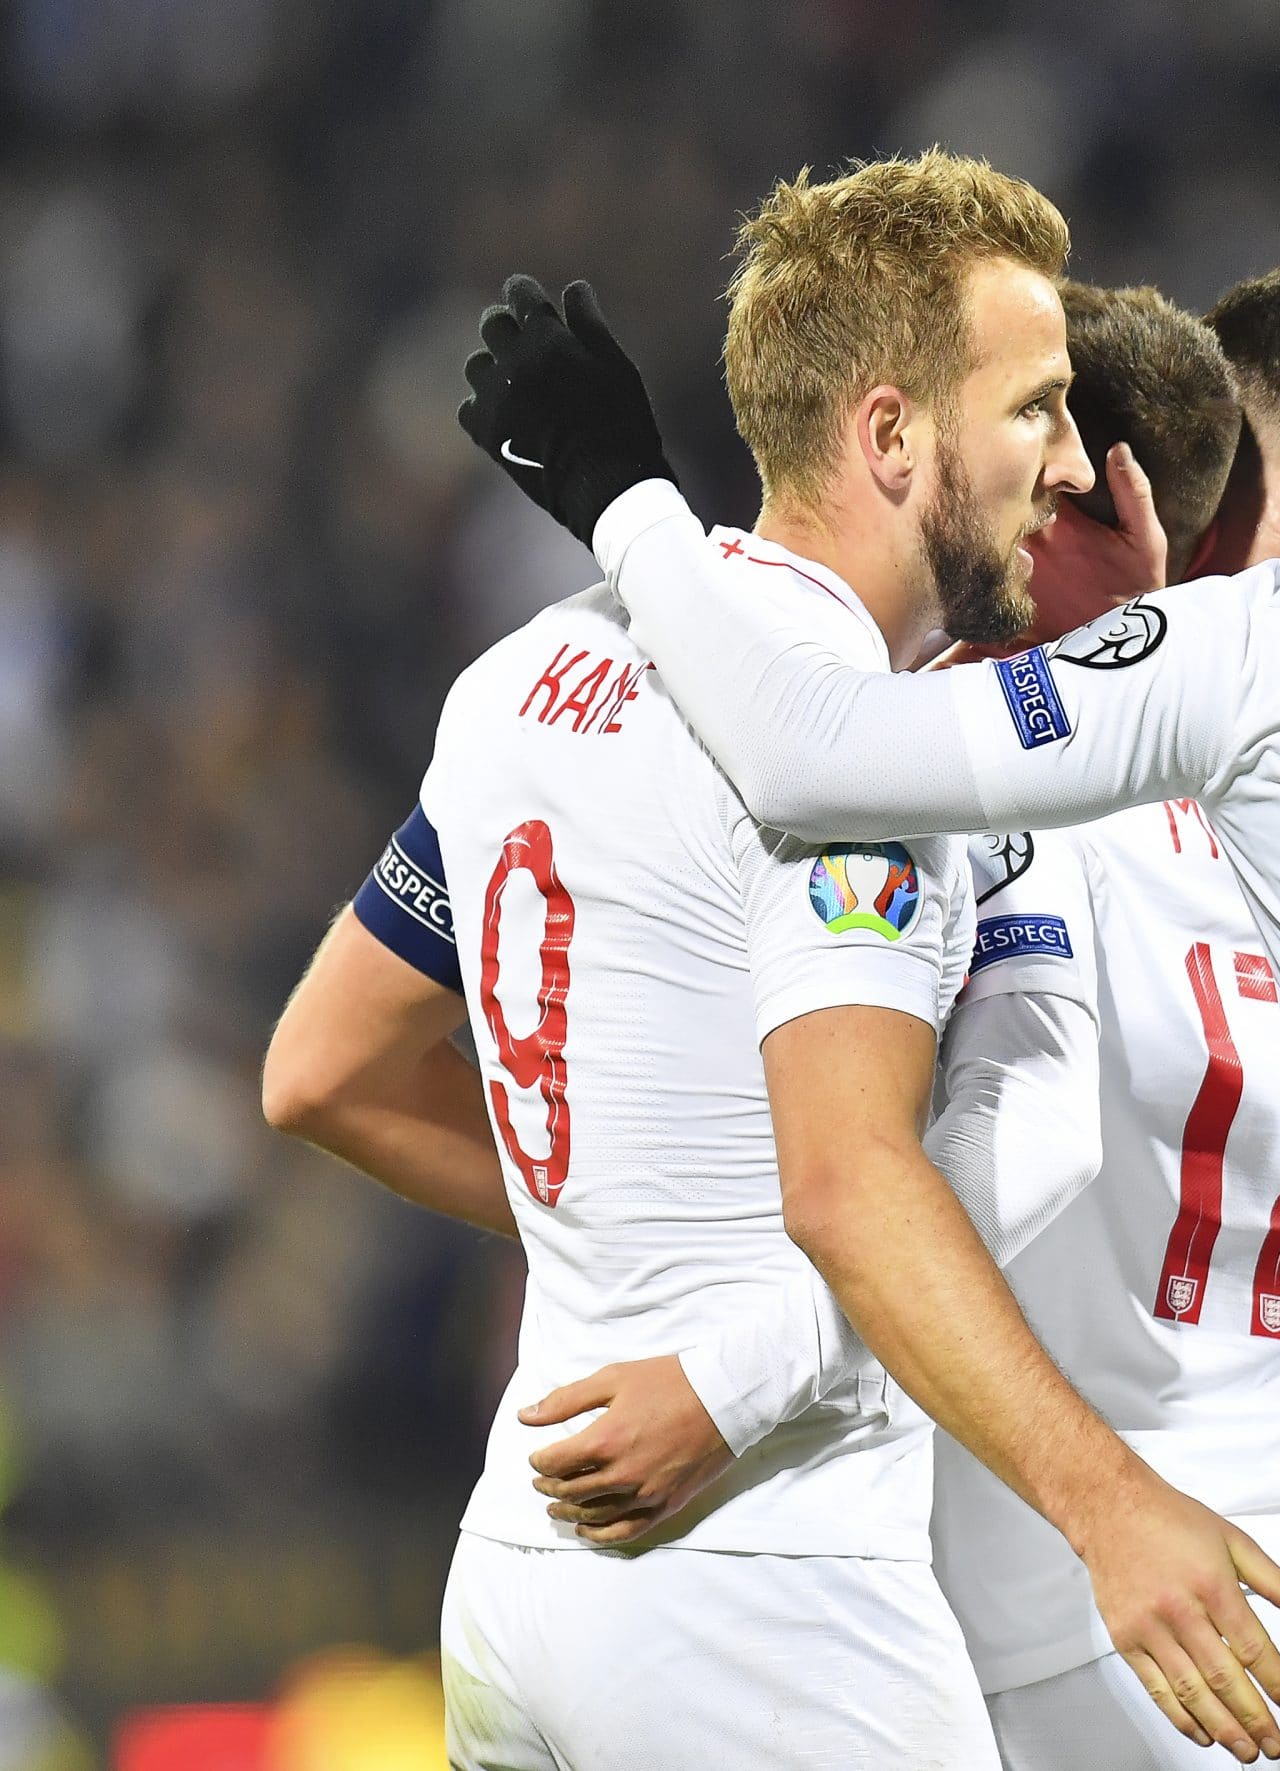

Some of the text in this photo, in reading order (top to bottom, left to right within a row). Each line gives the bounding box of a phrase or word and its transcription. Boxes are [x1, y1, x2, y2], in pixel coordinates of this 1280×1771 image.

[519, 644, 656, 734] KANE
[1008, 654, 1058, 739] RESPECT
[379, 845, 455, 932] RESPEC
[974, 924, 1067, 955] ESPECT
[480, 820, 575, 1208] 9
